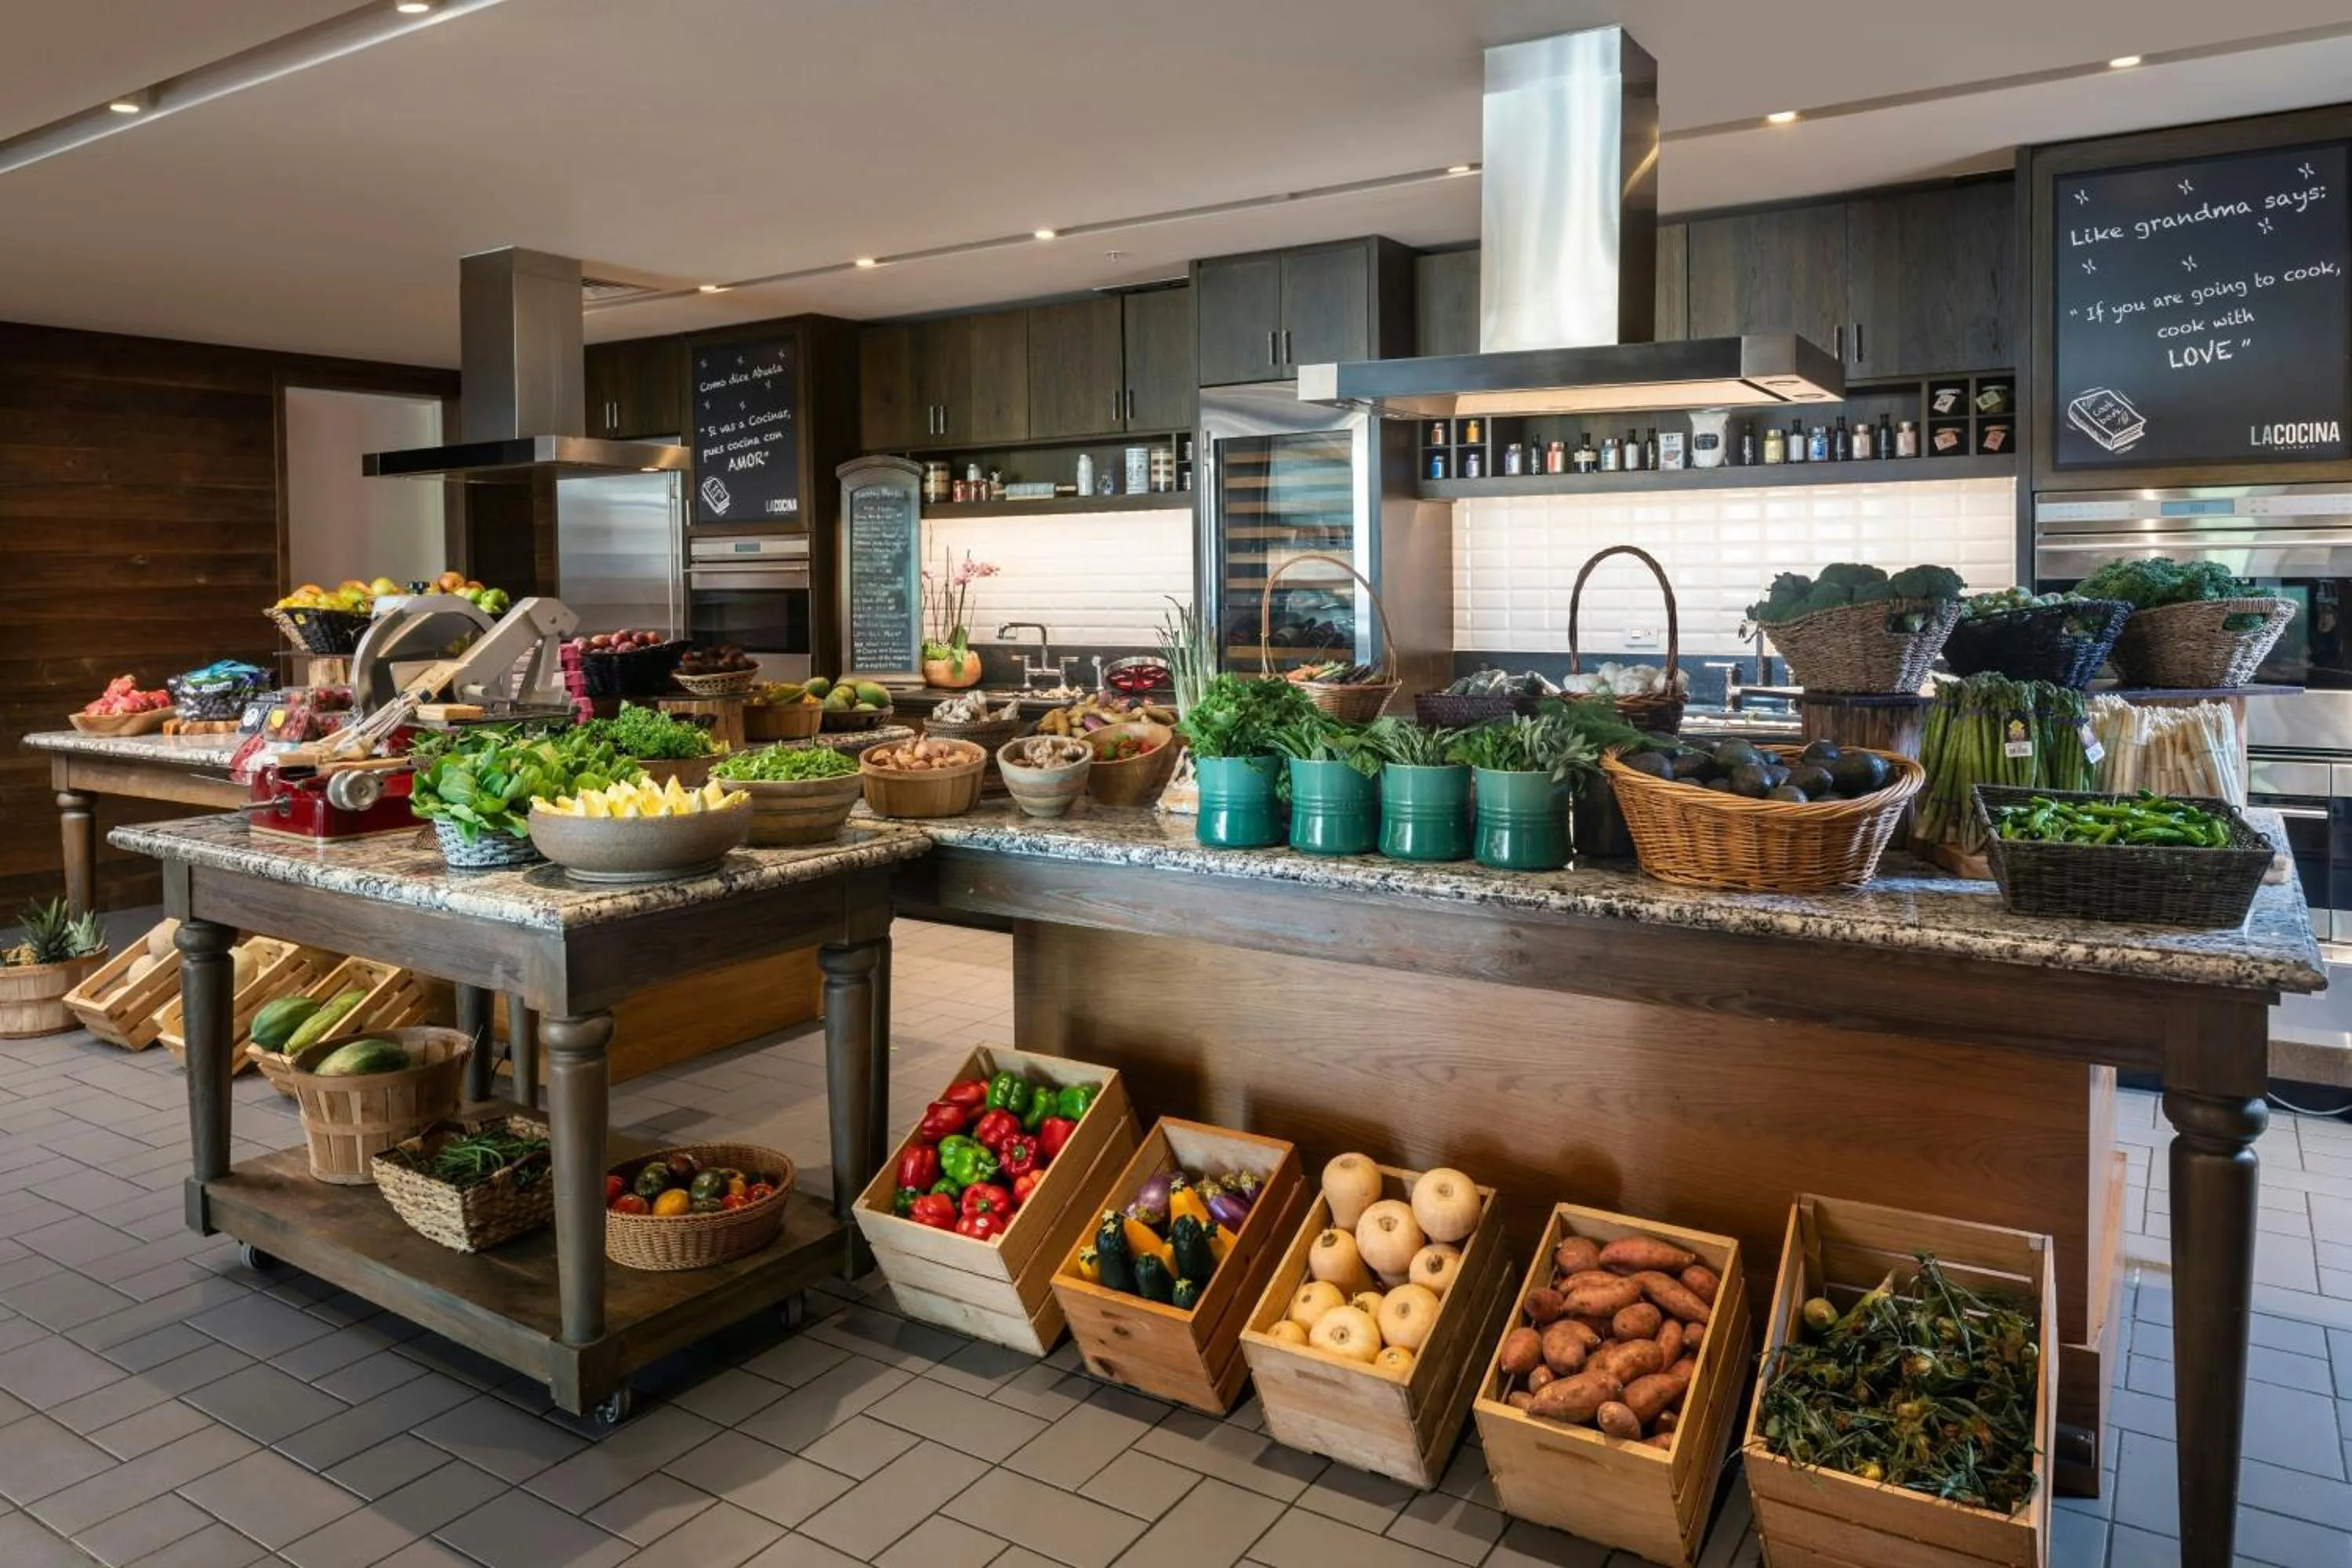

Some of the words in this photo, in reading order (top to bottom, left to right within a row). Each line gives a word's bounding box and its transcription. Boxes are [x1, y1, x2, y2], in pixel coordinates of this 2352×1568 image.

[2071, 227, 2124, 246] Like
[2135, 201, 2252, 239] grandma
[2264, 186, 2326, 212] says:
[2111, 301, 2146, 323] you
[2154, 293, 2183, 308] are
[2191, 281, 2248, 305] going
[2254, 273, 2274, 288] to
[2284, 261, 2341, 282] cook,
[2157, 319, 2205, 338] cook
[2212, 308, 2255, 328] with
[700, 379, 728, 393] Como
[728, 372, 750, 384] dice
[702, 445, 724, 463] pues
[727, 436, 760, 451] cocina
[764, 430, 784, 441] con
